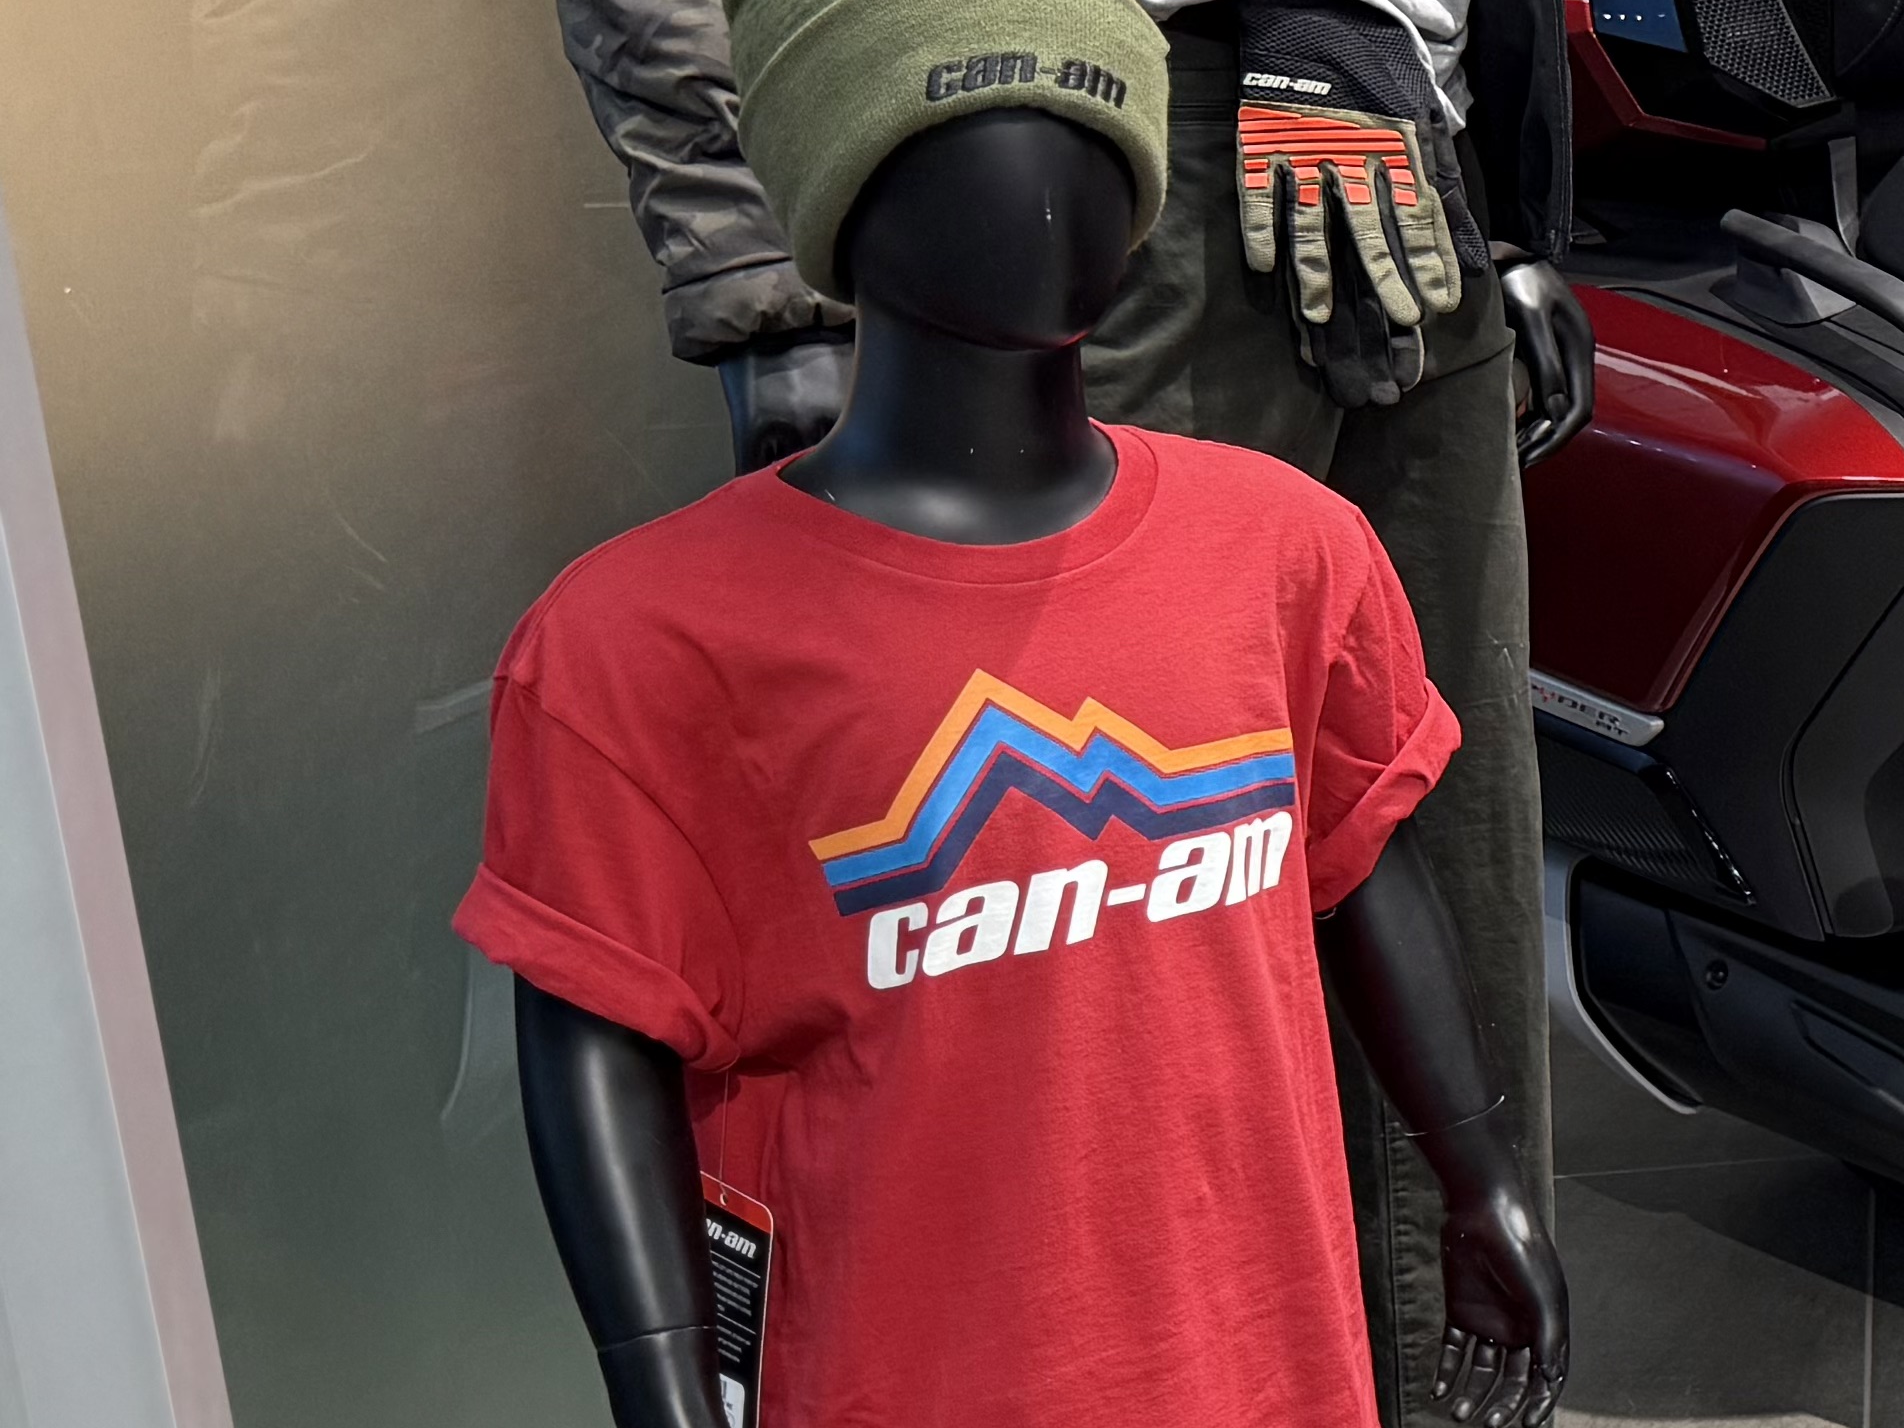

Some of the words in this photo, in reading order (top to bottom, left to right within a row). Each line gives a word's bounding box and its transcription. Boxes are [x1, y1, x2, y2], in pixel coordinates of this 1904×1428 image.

[926, 52, 1127, 109] can-am
[1243, 72, 1332, 95] can-am
[1531, 683, 1620, 723] YDER
[867, 811, 1293, 990] can-am
